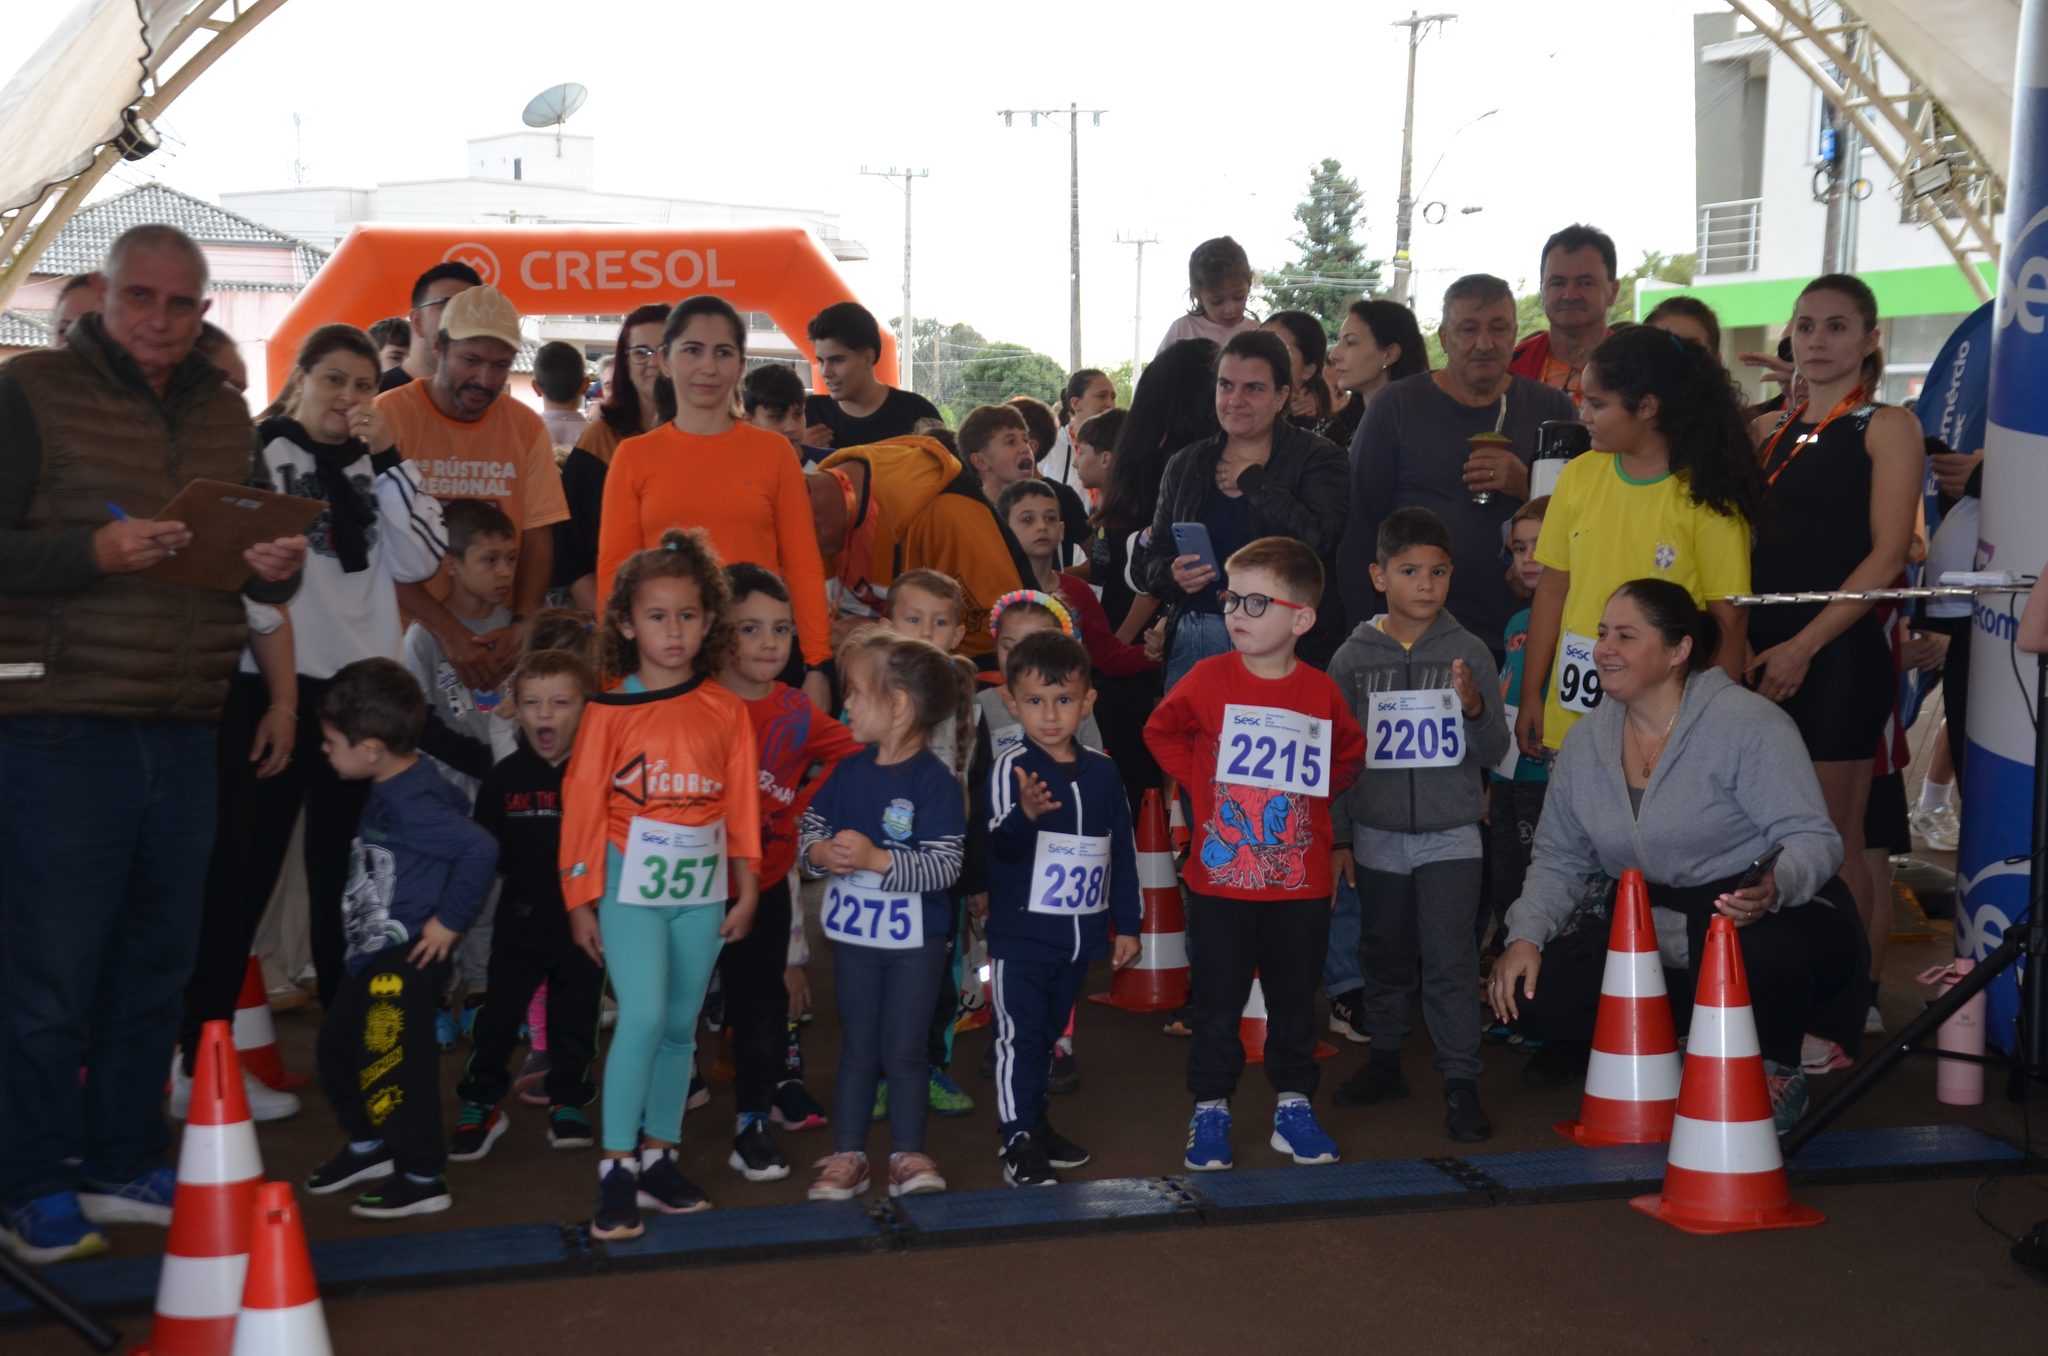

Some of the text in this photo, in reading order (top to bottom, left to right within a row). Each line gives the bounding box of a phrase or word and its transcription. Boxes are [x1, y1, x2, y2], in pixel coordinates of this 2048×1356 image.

[519, 248, 736, 291] CRESOL
[433, 456, 517, 479] RÚSTICA
[1227, 733, 1321, 787] 2215
[1374, 717, 1459, 760] 2205
[640, 853, 719, 900] 357
[825, 886, 911, 941] 2275
